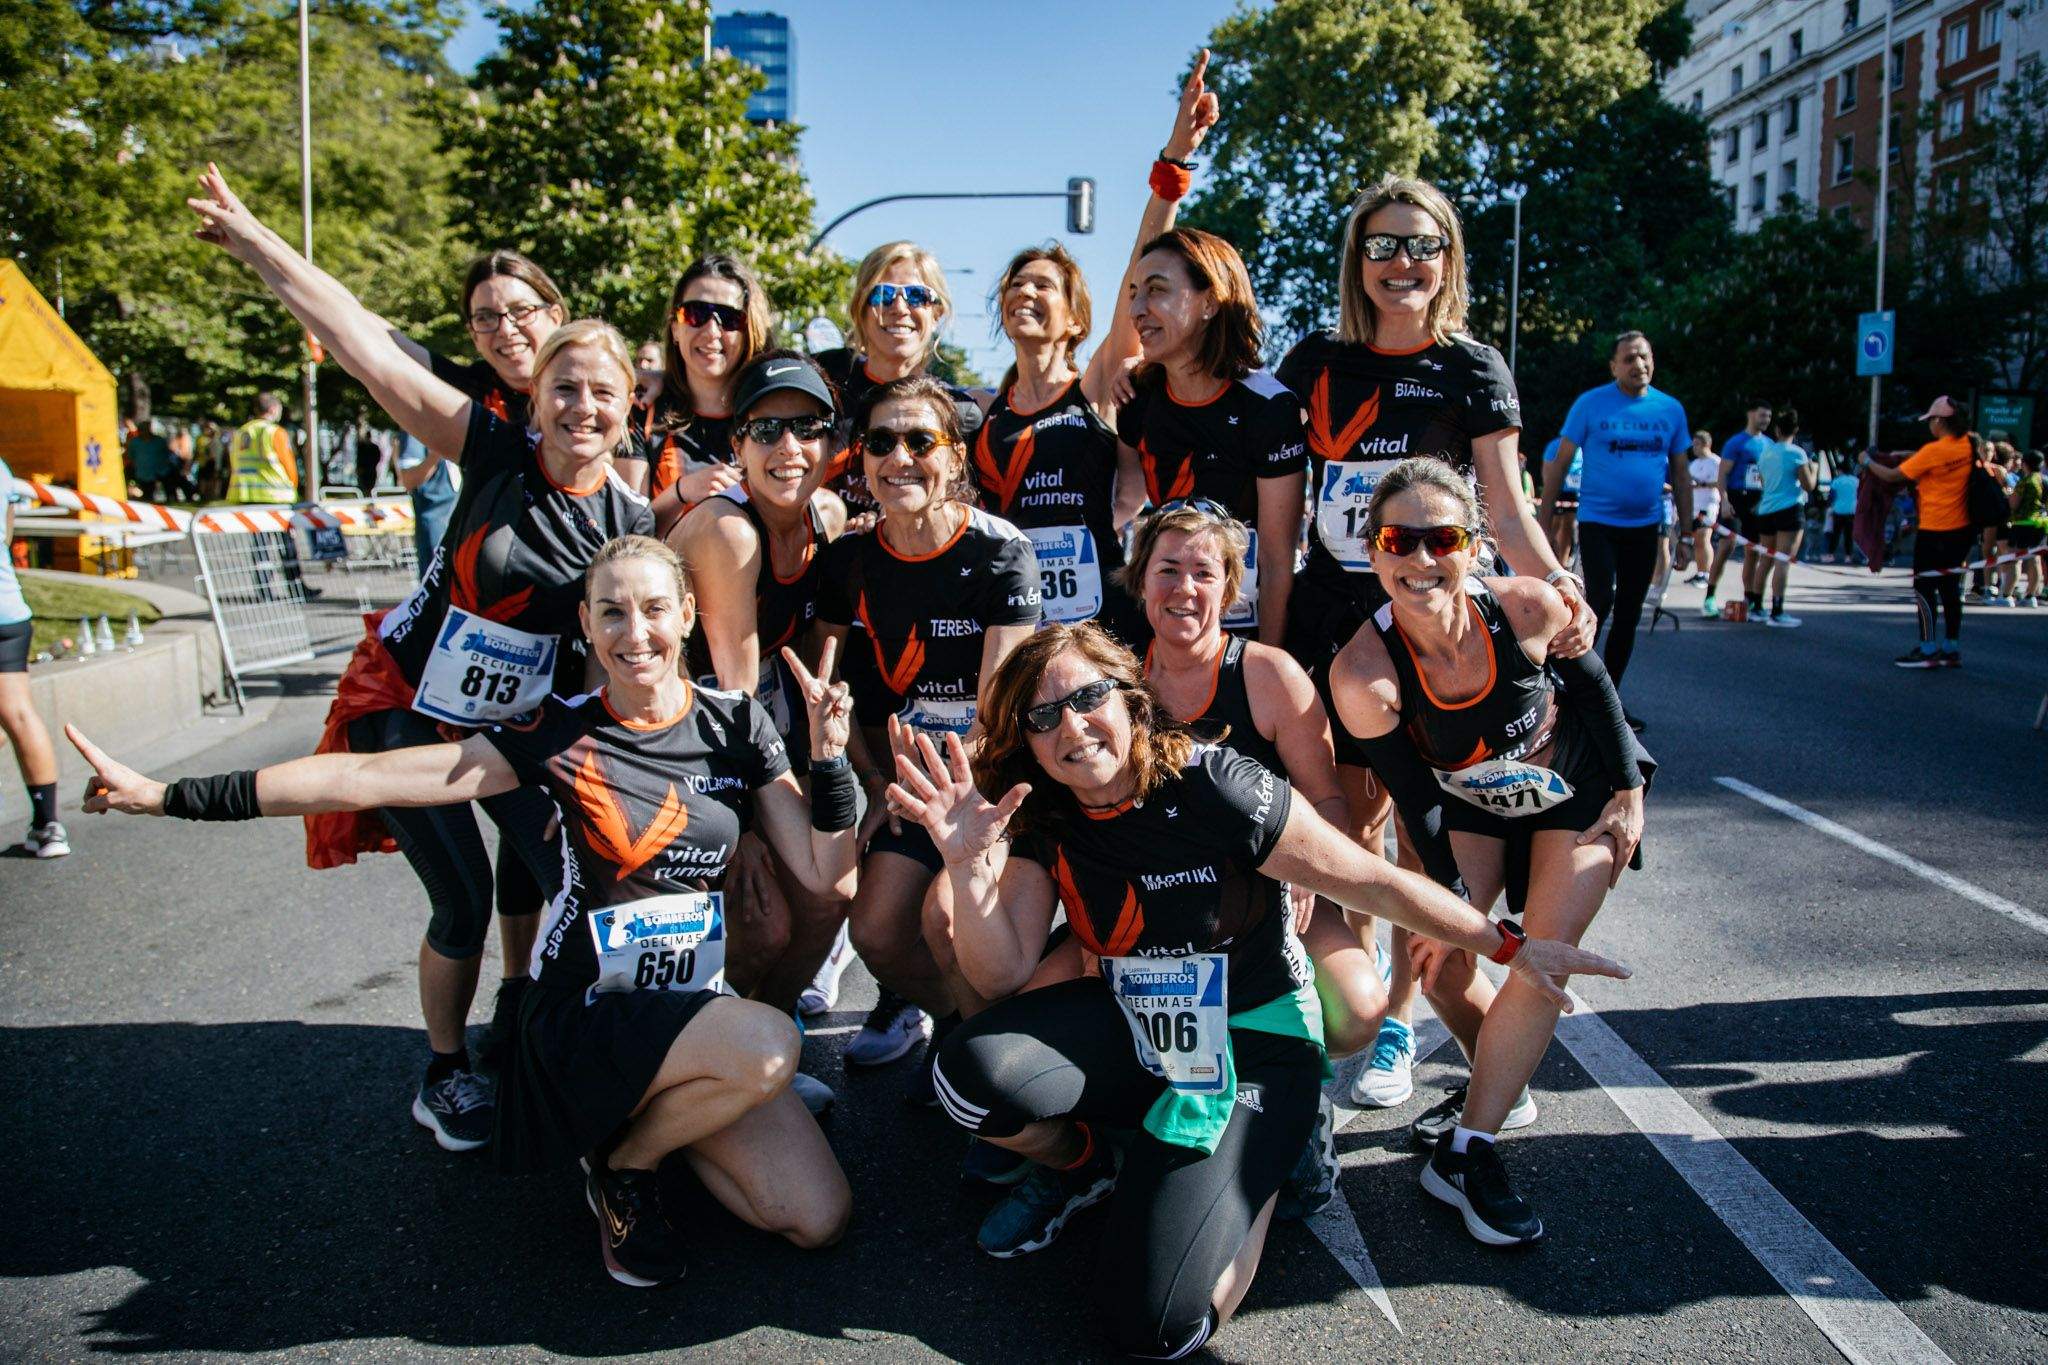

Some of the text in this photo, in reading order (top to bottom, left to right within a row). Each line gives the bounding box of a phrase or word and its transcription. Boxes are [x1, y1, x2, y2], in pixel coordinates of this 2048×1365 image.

[1036, 413, 1088, 429] CRISTINA
[1360, 433, 1408, 455] vital
[1025, 468, 1063, 490] vital
[1021, 491, 1084, 508] runners
[1033, 540, 1074, 551] MBEROS
[1040, 557, 1074, 568] IMAS
[931, 618, 983, 637] TERESA
[483, 639, 541, 658] BOMBEROS
[470, 652, 535, 676] DECIMAS
[461, 665, 521, 705] 813
[917, 678, 965, 694] vital
[1506, 707, 1538, 738] STEF
[667, 844, 727, 864] vital
[547, 895, 580, 960] rnners
[641, 933, 702, 949] DECIMAS
[1137, 942, 1195, 957] vital
[635, 948, 696, 989] 650
[1129, 974, 1195, 985] BOMBEROS
[1236, 1094, 1264, 1113] didas
